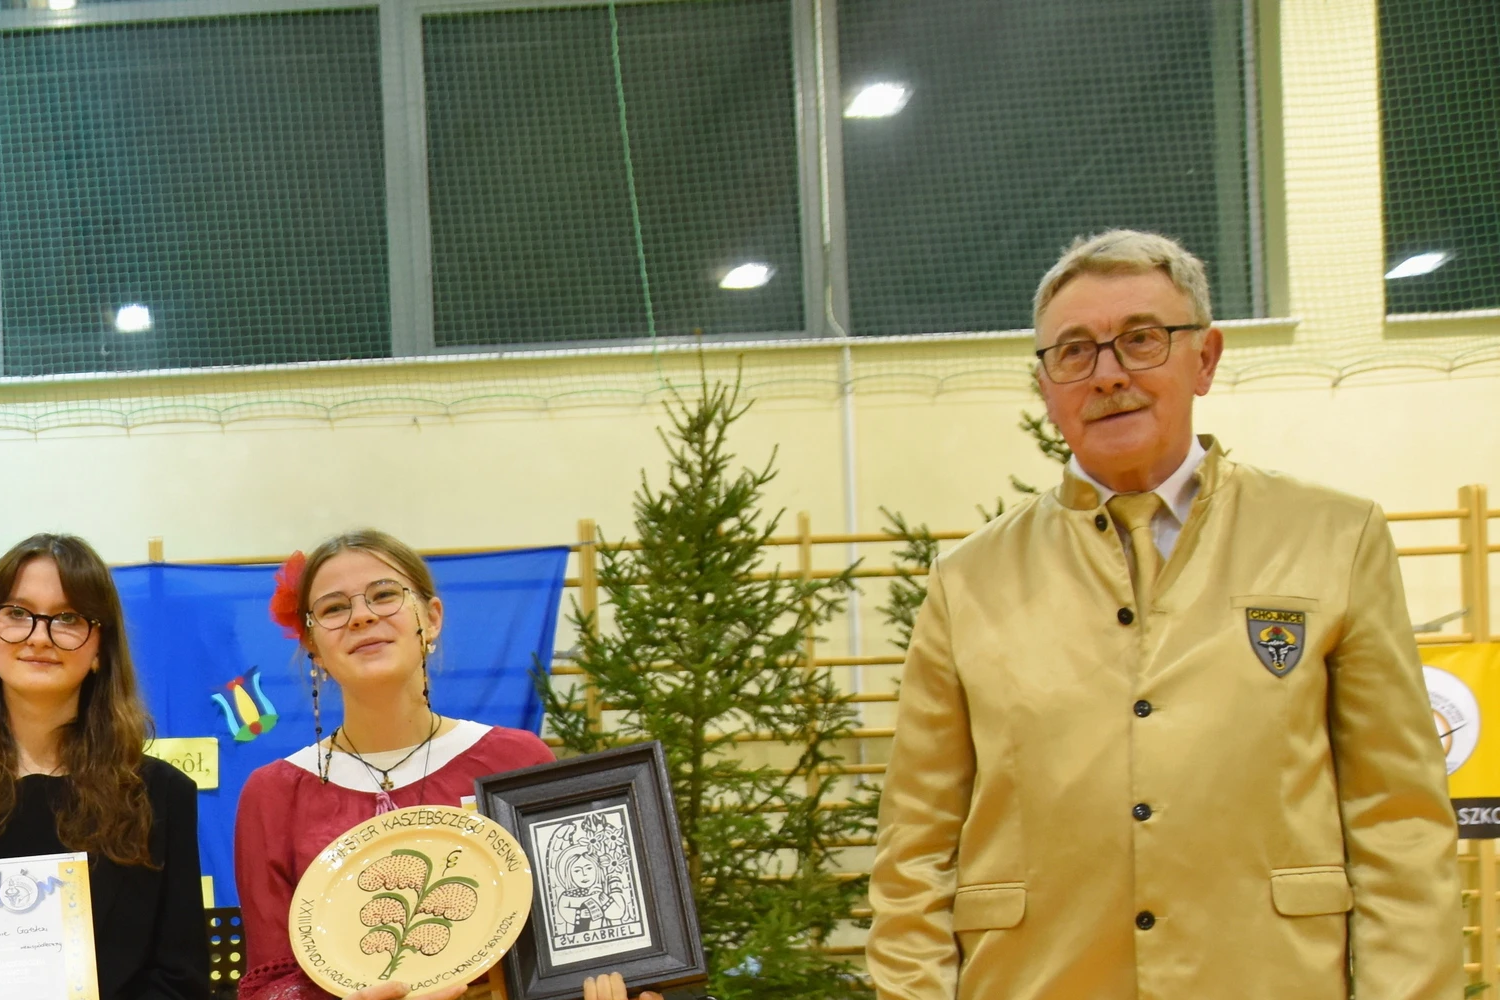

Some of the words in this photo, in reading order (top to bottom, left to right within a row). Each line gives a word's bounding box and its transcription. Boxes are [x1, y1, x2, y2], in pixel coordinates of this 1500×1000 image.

[1249, 610, 1303, 622] CHOJNICE
[298, 898, 315, 924] XXIII
[583, 925, 635, 942] GABRIEL
[298, 926, 326, 967] DIKTANDO
